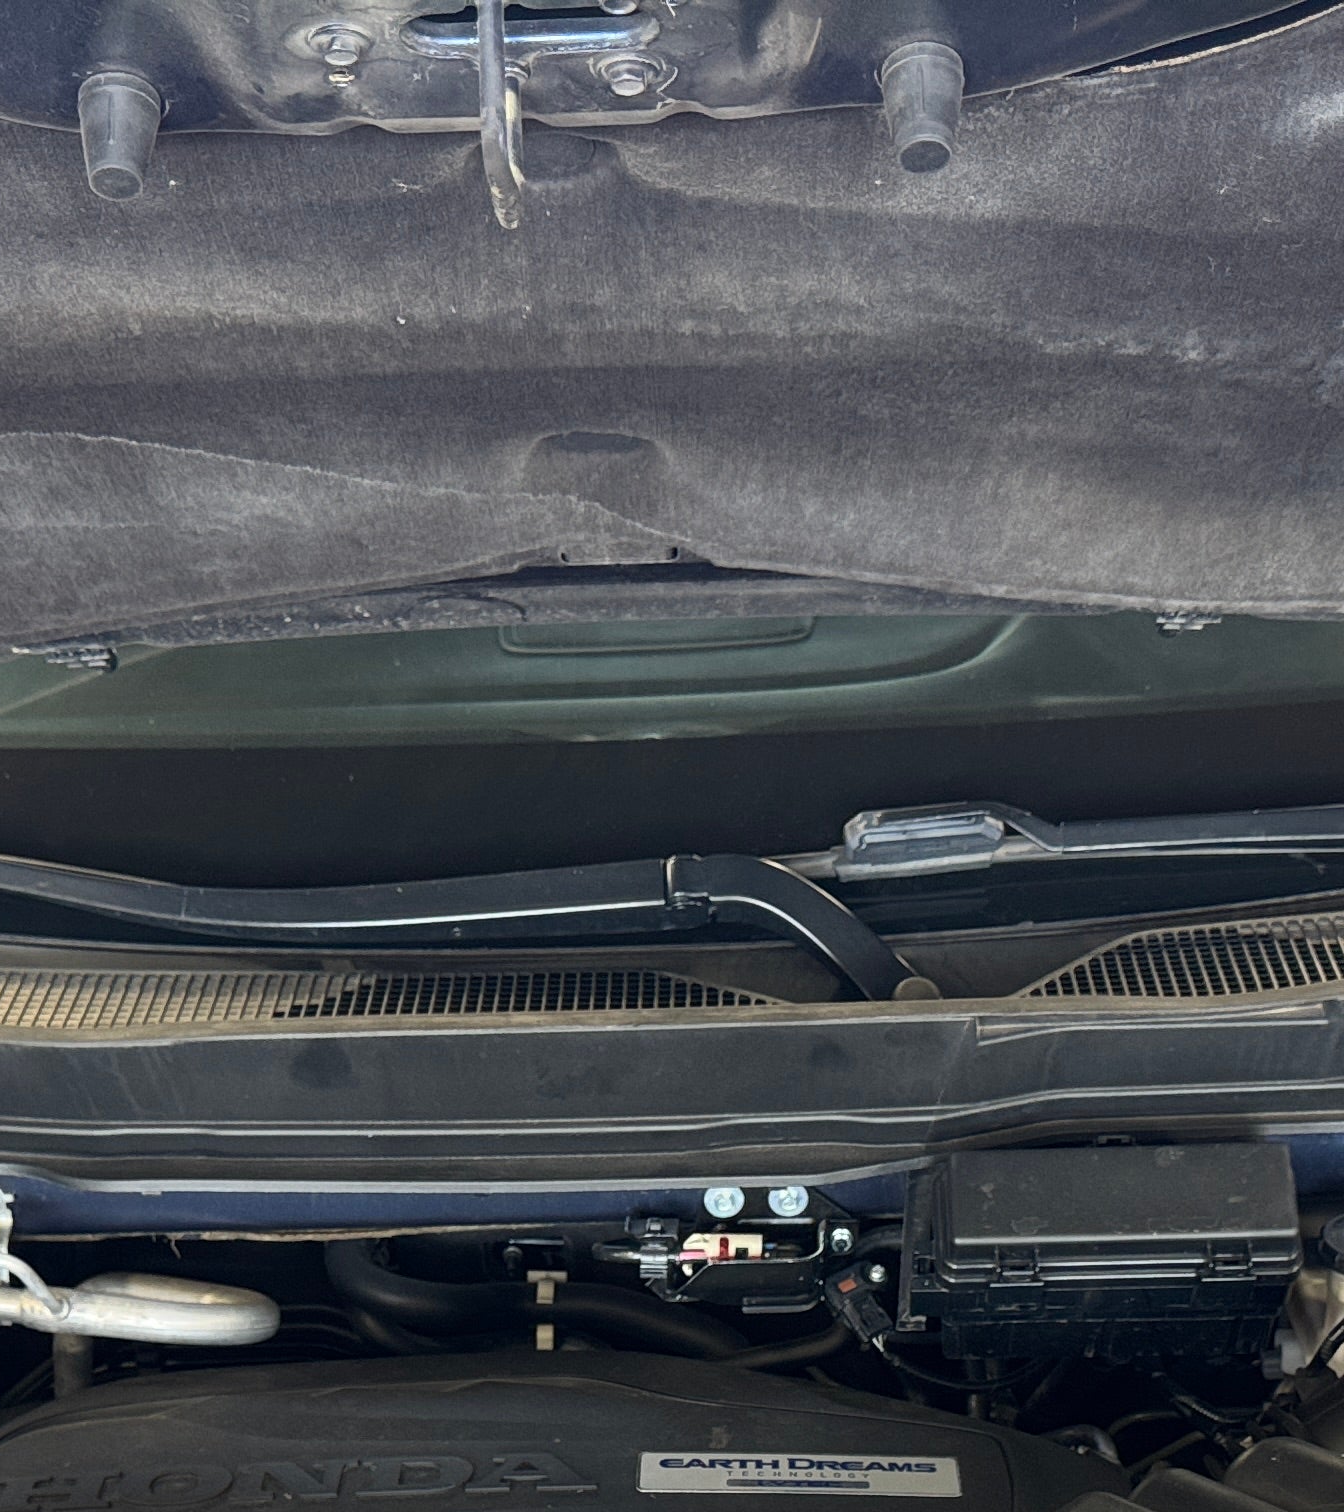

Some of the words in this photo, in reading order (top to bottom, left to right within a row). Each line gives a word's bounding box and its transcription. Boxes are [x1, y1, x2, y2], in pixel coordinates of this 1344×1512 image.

[659, 1458, 780, 1470] EARTH
[787, 1458, 937, 1473] DREAMS
[726, 1470, 871, 1479] TECHNOLOGY
